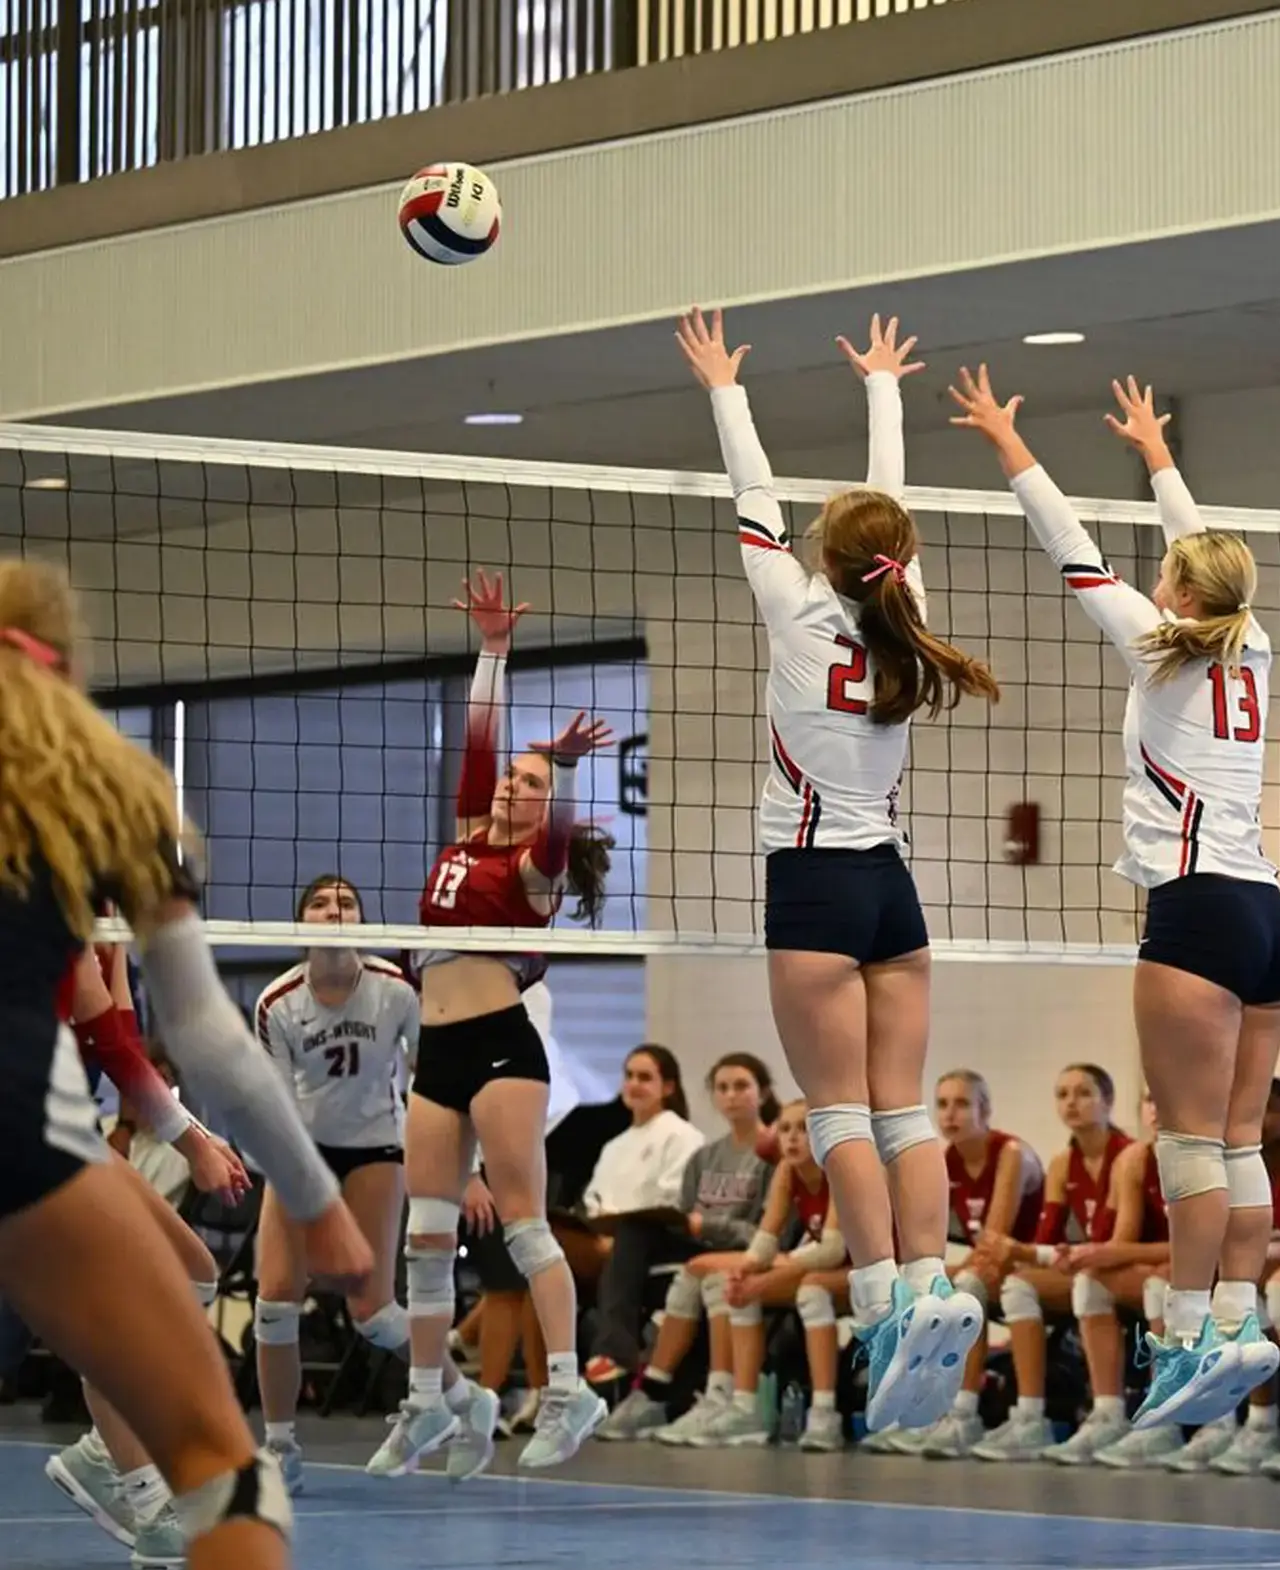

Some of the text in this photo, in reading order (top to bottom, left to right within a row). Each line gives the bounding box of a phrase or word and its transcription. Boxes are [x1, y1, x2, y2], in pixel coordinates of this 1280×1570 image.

[446, 168, 465, 208] Wilson
[827, 633, 868, 715] 2
[1207, 661, 1261, 742] 13
[431, 861, 468, 909] 13
[324, 1042, 361, 1078] 21
